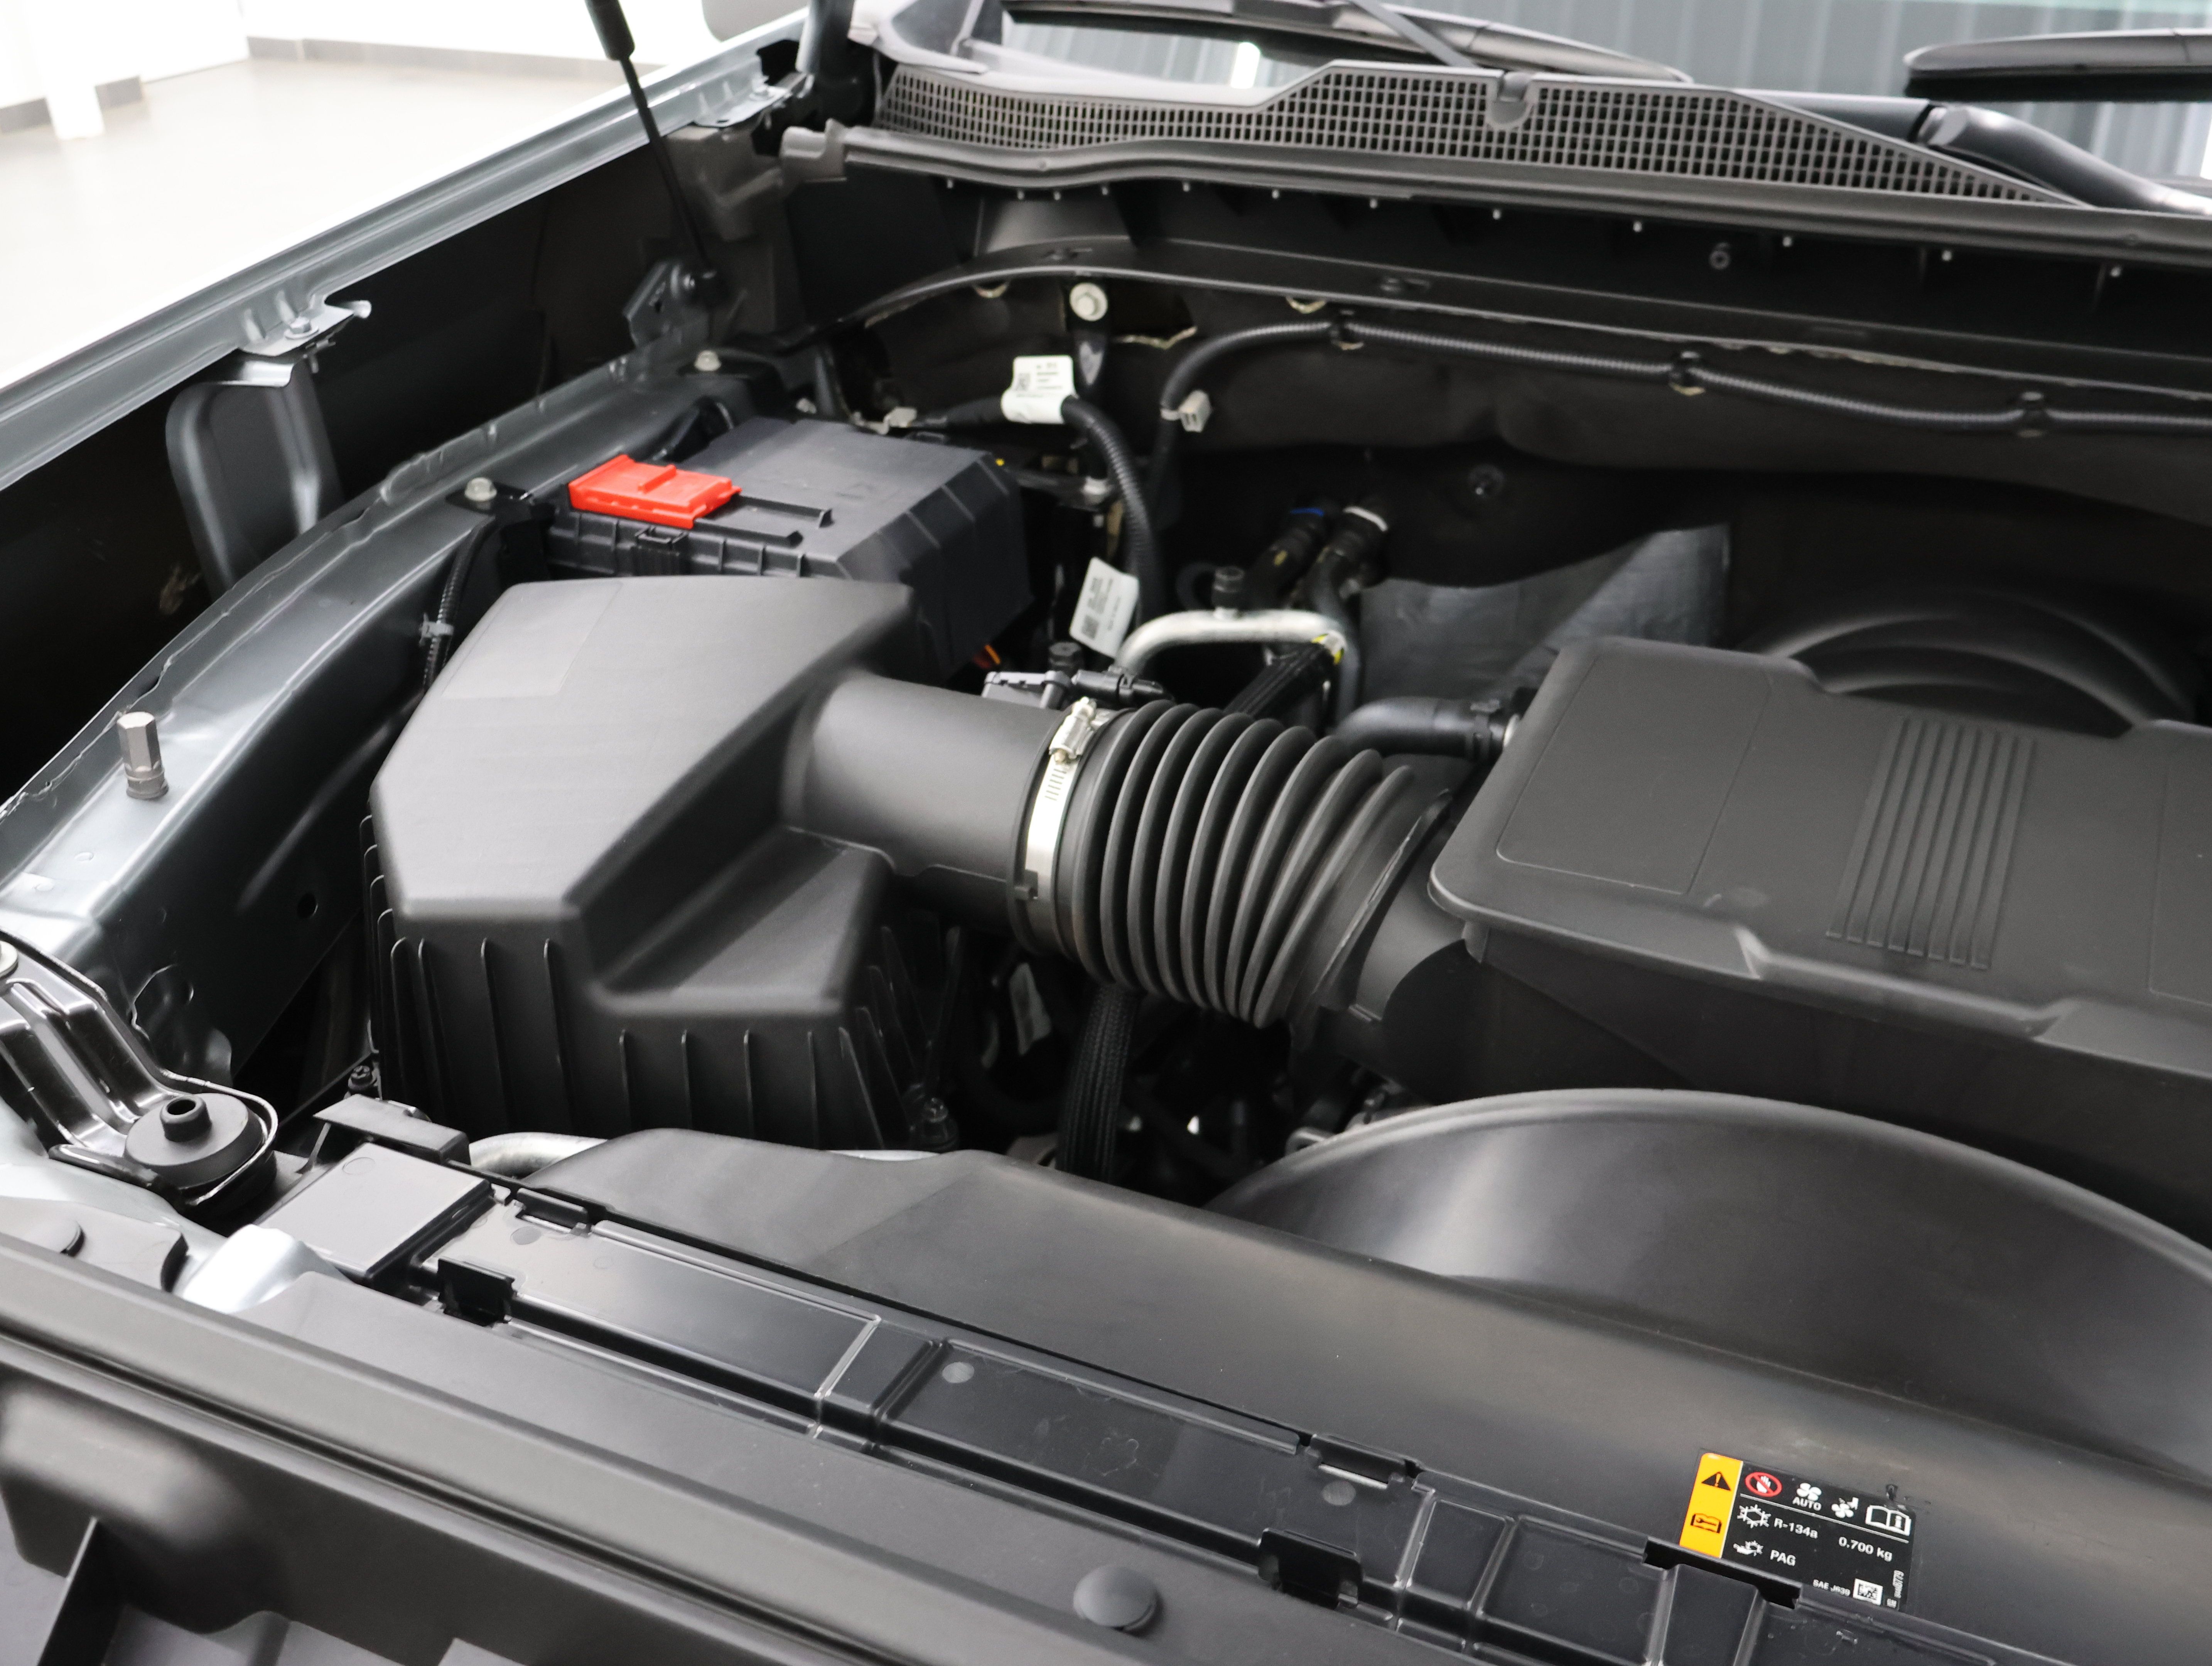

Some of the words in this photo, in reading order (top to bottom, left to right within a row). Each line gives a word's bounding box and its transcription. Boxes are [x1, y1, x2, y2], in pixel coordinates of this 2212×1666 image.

[1792, 1496, 1822, 1511] AUTO
[1774, 1518, 1818, 1539] R-134a
[1770, 1549, 1796, 1566] PAG
[1838, 1537, 1874, 1555] 0.700
[1876, 1547, 1892, 1561] kg
[1812, 1579, 1829, 1590] SAE
